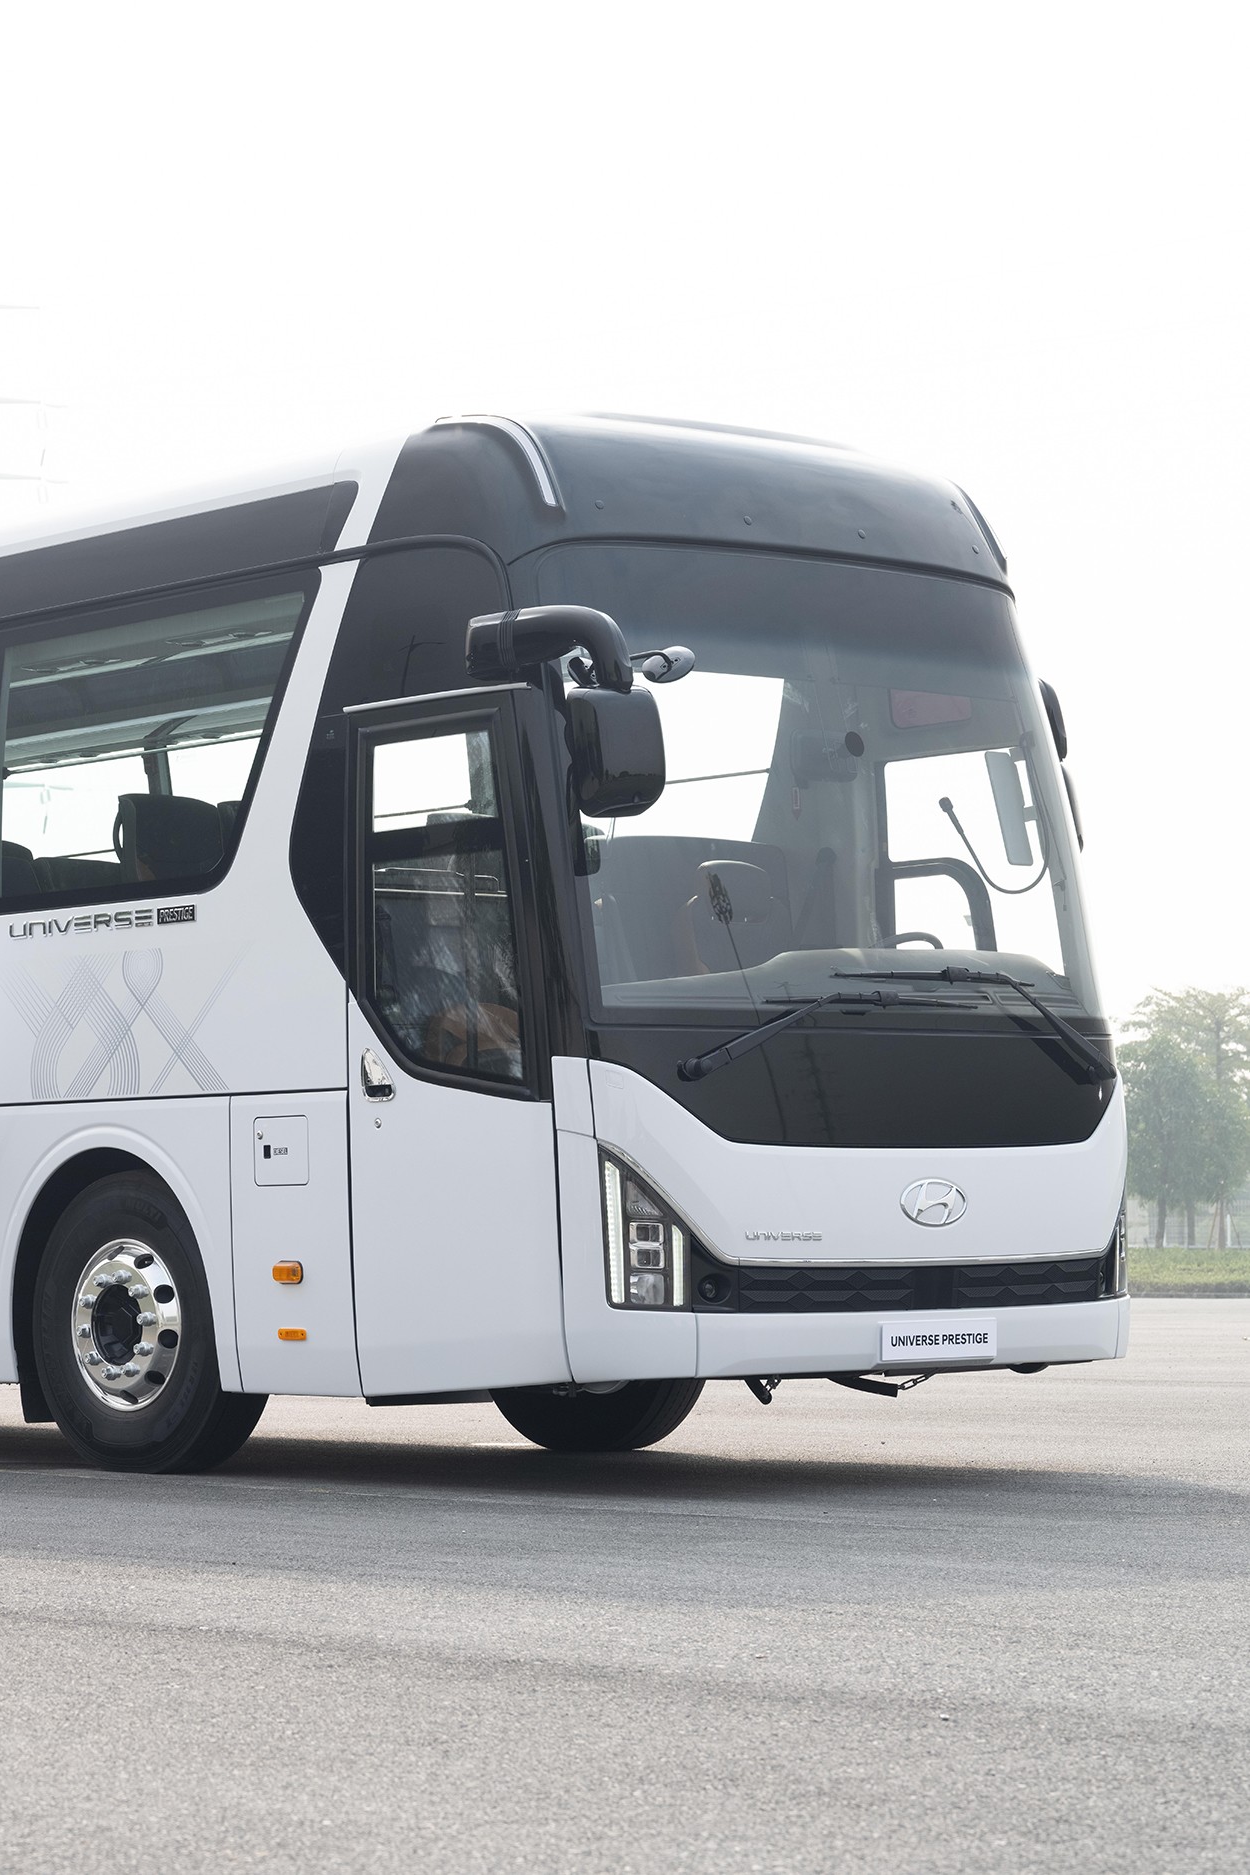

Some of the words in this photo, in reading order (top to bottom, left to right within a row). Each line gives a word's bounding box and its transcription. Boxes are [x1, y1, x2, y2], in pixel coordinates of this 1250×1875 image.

[9, 909, 153, 939] UNIVERSE
[158, 905, 194, 923] PRESTIGE
[745, 1231, 822, 1241] UNIVERSE
[891, 1334, 940, 1347] UNIVERSE
[941, 1332, 989, 1345] PRESTIGE
